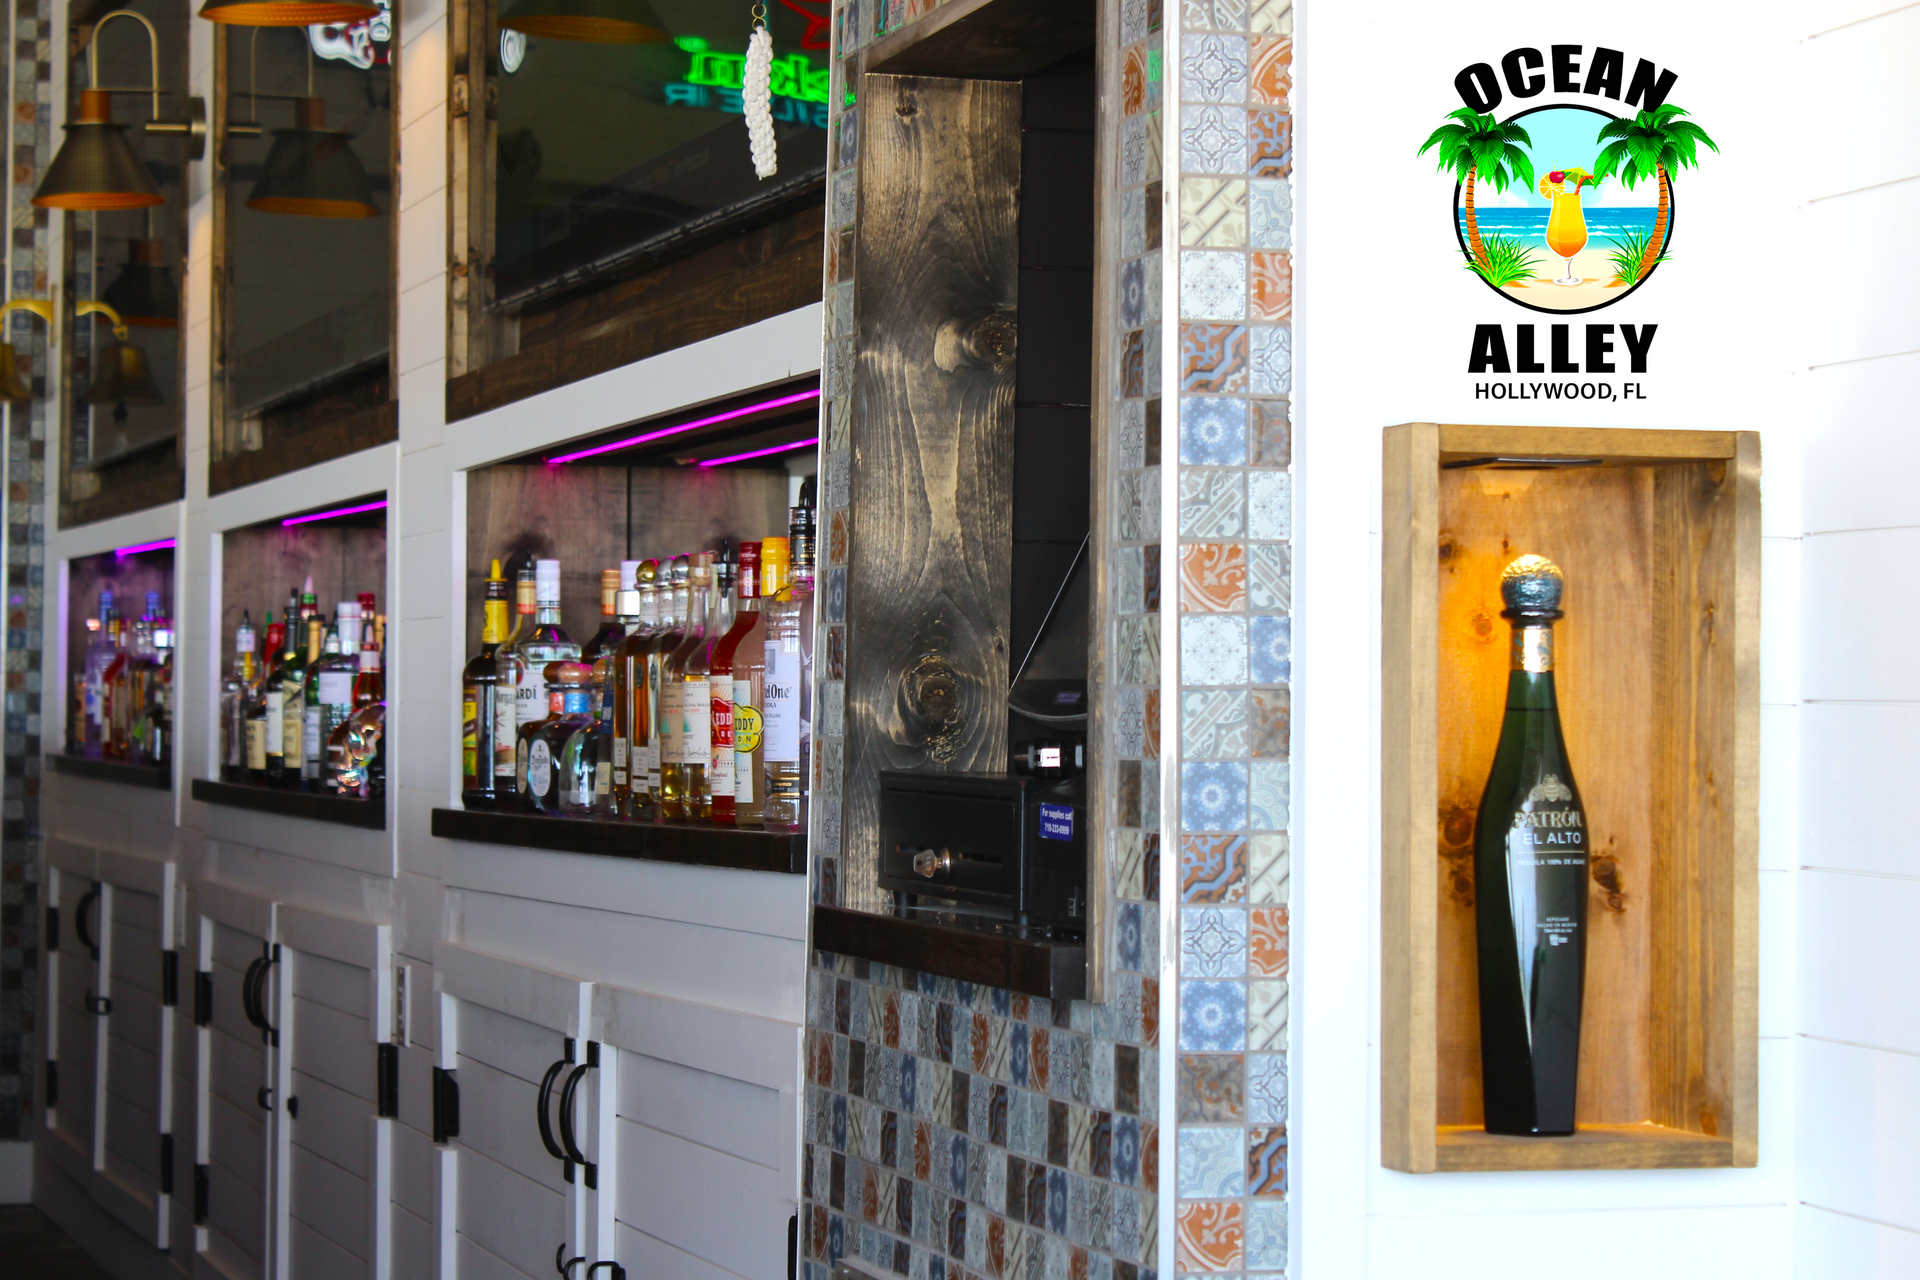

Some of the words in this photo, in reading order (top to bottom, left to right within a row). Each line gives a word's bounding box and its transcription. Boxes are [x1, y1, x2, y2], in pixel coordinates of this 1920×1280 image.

[1049, 810, 1065, 820] supplies
[1513, 807, 1582, 828] PATRÓN
[1523, 832, 1543, 845] EL
[1546, 832, 1581, 844] ALTO
